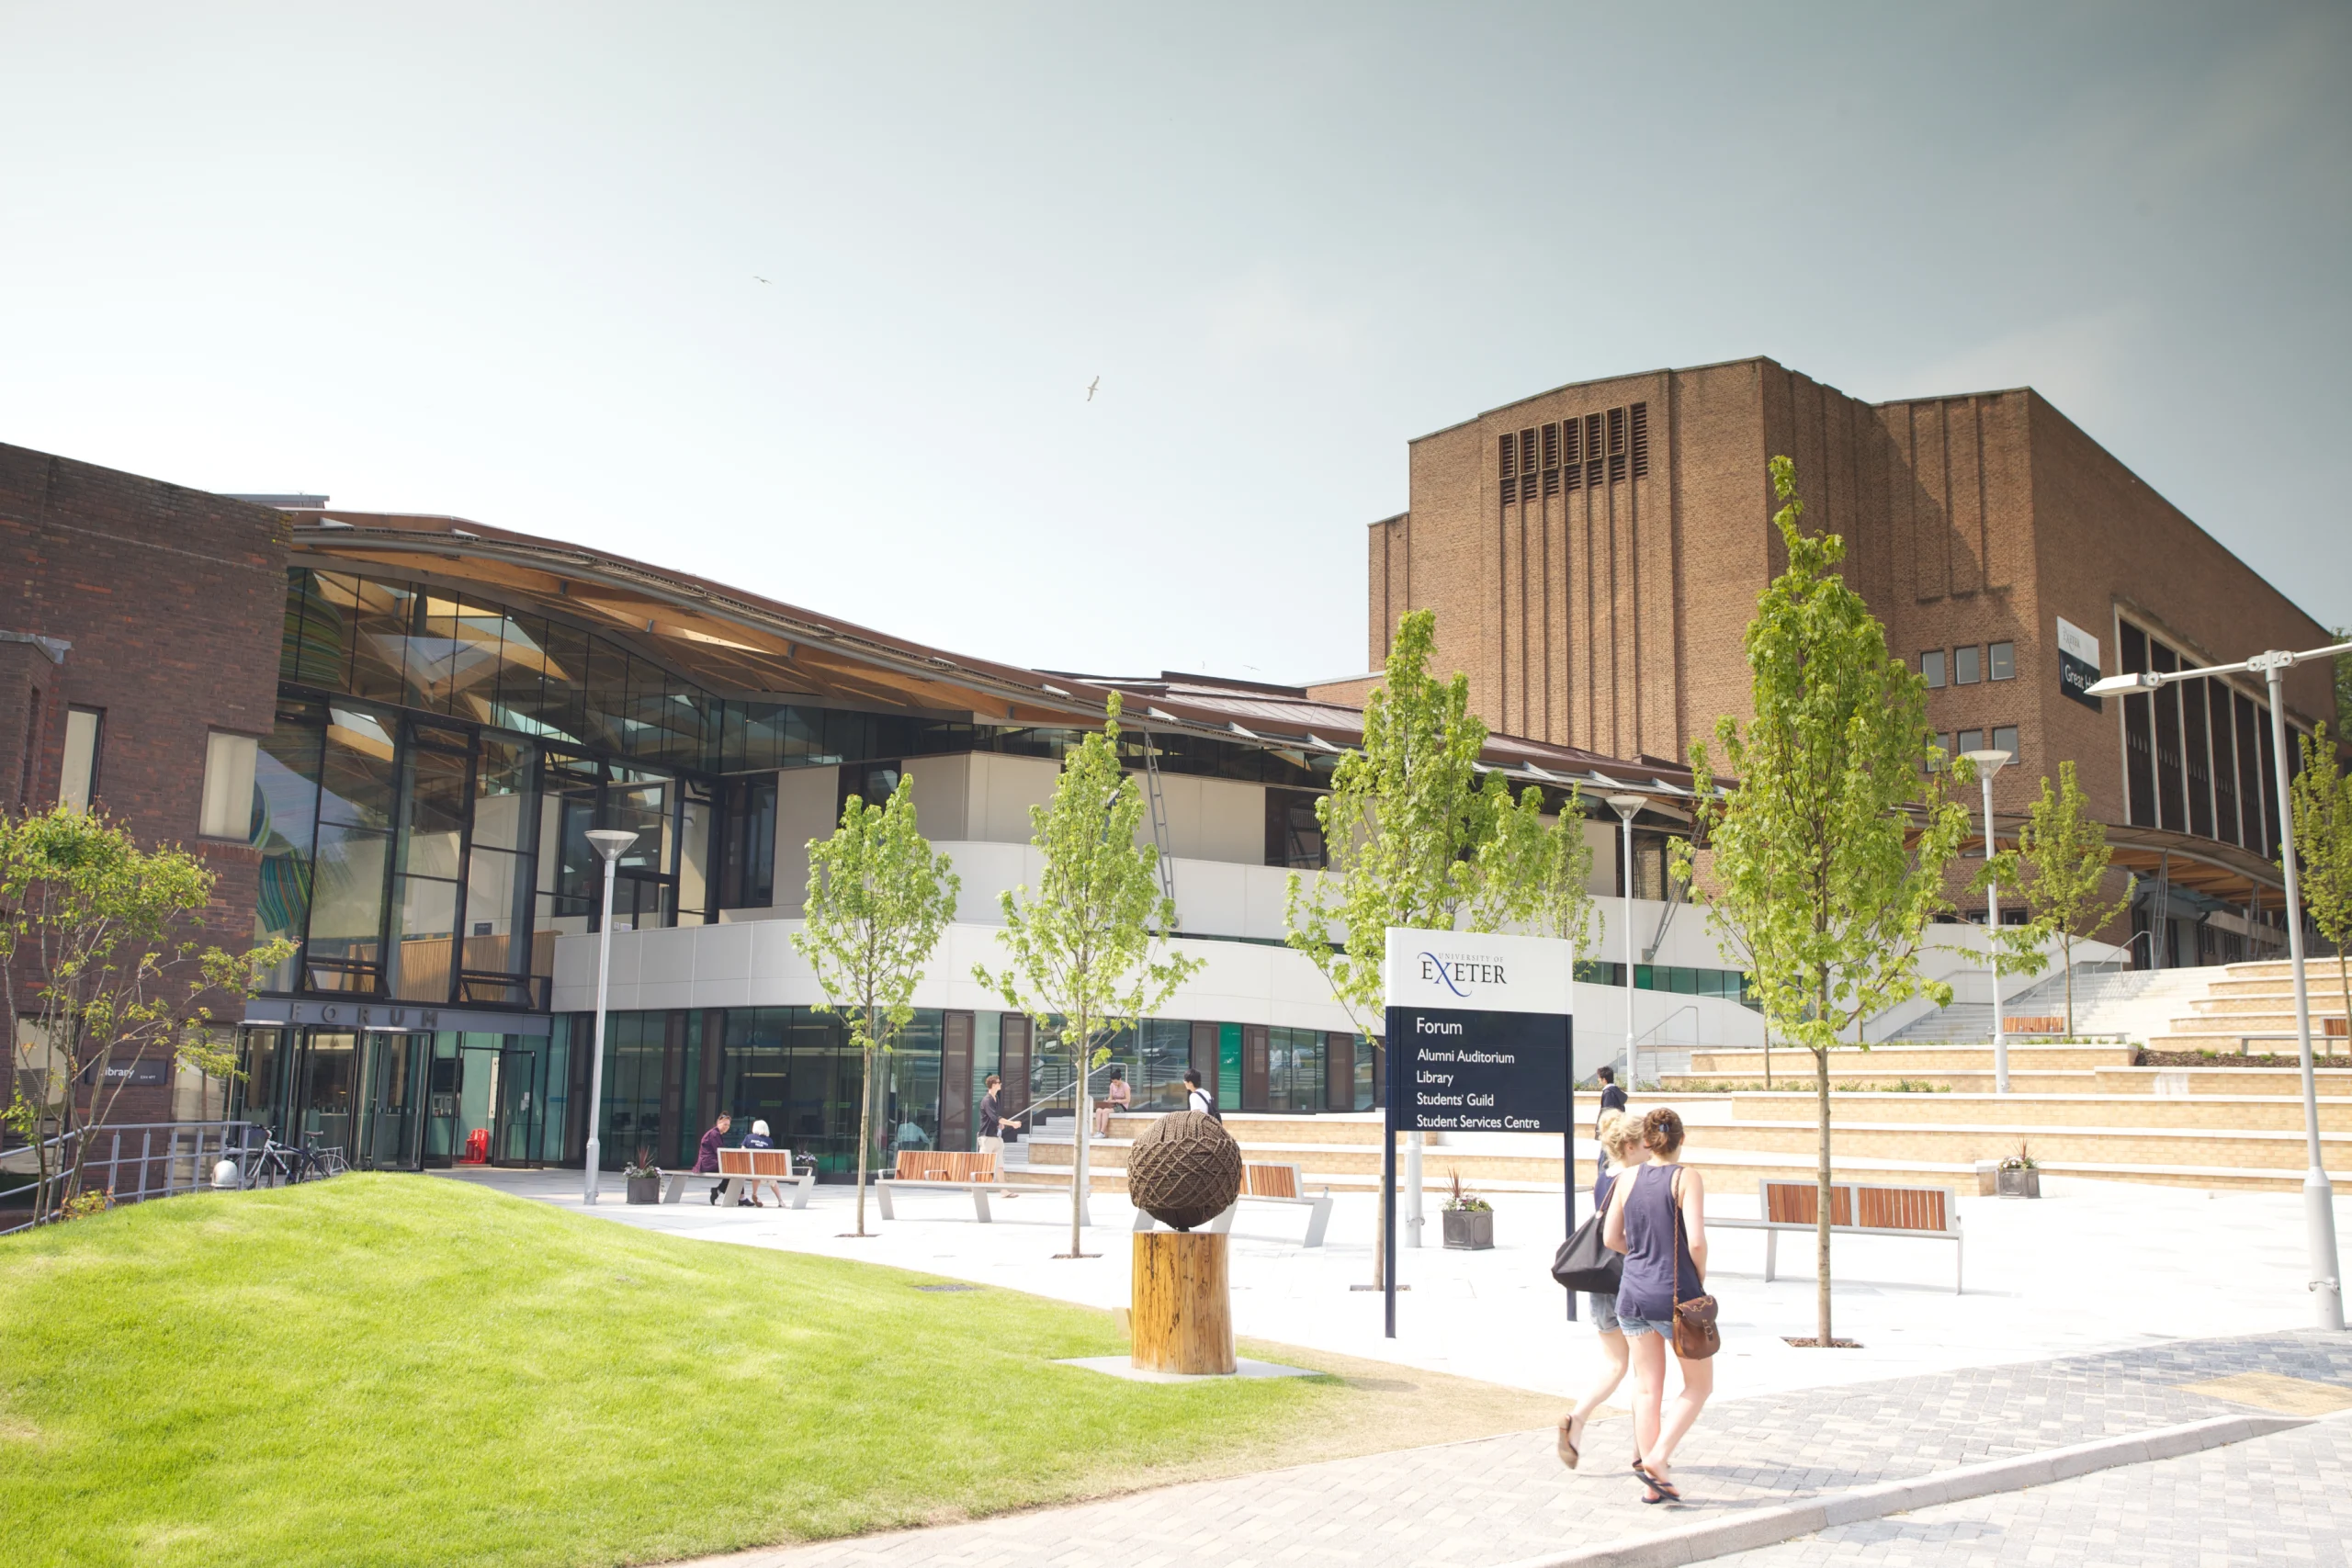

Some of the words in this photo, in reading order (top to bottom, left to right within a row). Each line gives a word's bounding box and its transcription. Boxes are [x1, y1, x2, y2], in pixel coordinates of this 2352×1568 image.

[2064, 664, 2085, 690] Great
[1438, 953, 1491, 963] UNIVERSITY
[1418, 954, 1508, 997] EXETER
[290, 1002, 438, 1028] FORUM
[1416, 1017, 1463, 1035] Forum
[1417, 1048, 1454, 1062] Alumni
[1457, 1050, 1515, 1064] Auditorium
[100, 1066, 135, 1079] ibrary
[1416, 1070, 1453, 1087] Library
[1417, 1092, 1464, 1106] Students'
[1466, 1093, 1494, 1106] Guild
[1417, 1114, 1458, 1128] Student
[1460, 1115, 1501, 1128] Services
[1504, 1117, 1540, 1129] Centre
